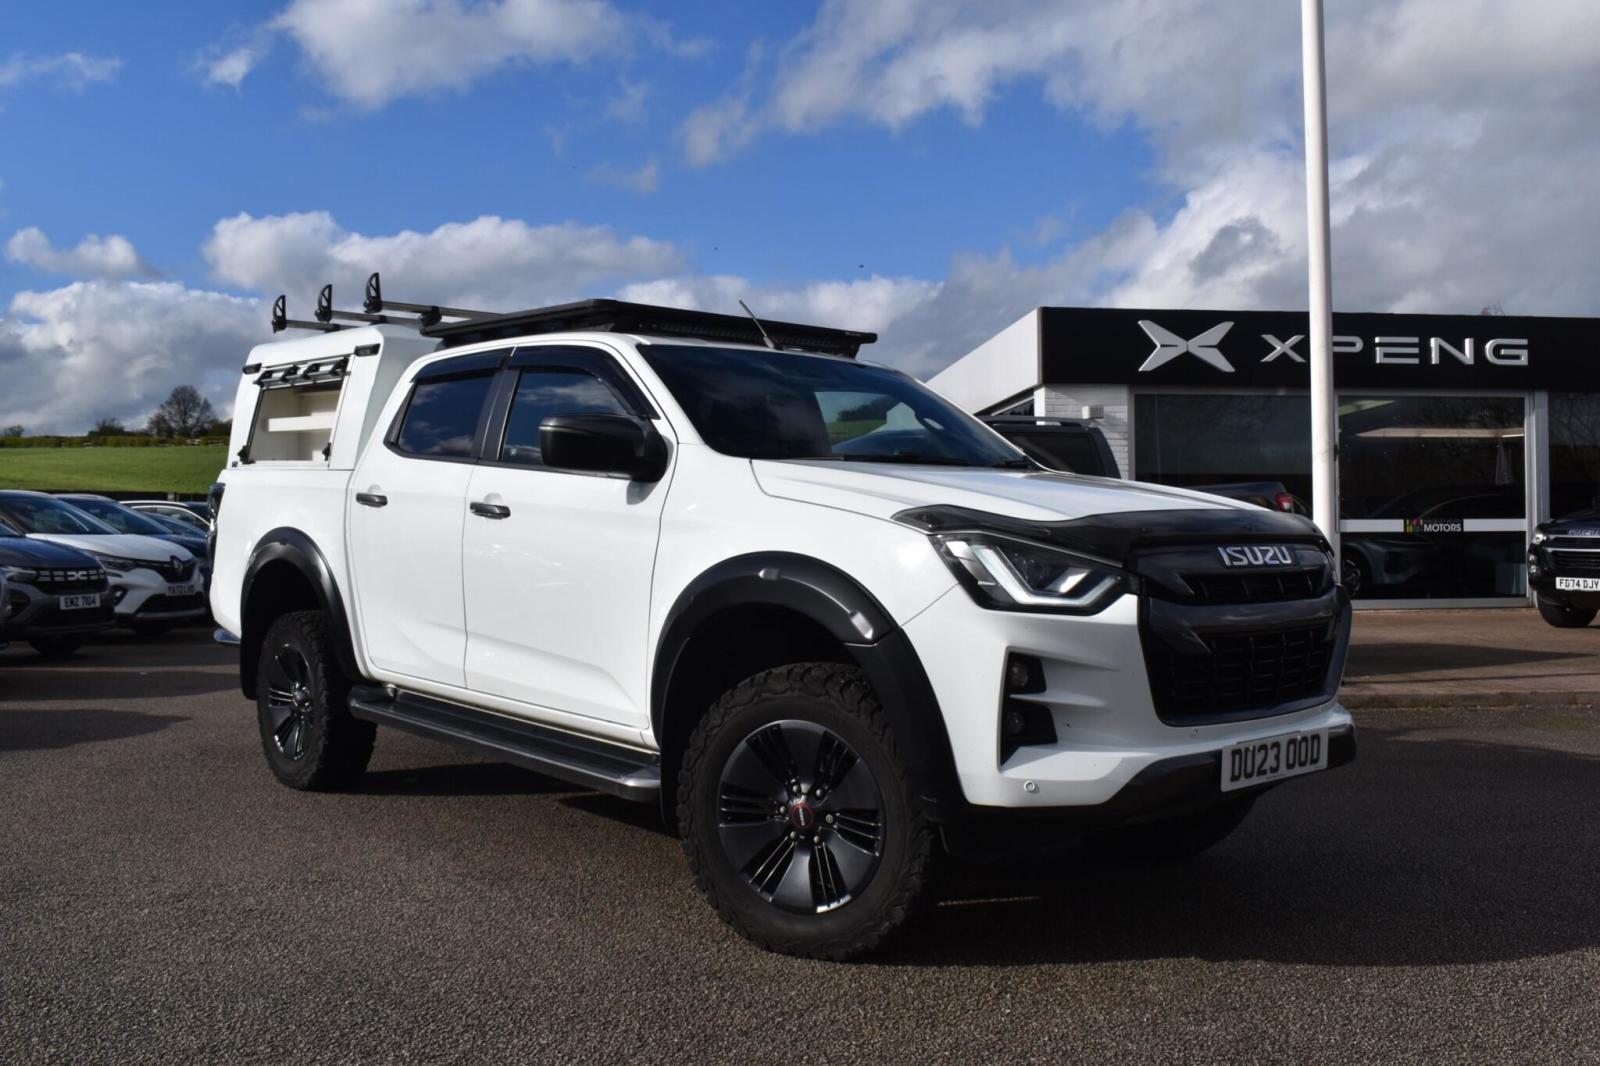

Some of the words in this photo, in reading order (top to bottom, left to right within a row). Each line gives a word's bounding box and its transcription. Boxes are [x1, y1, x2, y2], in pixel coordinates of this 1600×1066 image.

[1260, 334, 1528, 366] XPENG
[1424, 523, 1461, 532] MOTORS
[1217, 546, 1292, 566] ISUZU
[1230, 741, 1281, 782] DU23
